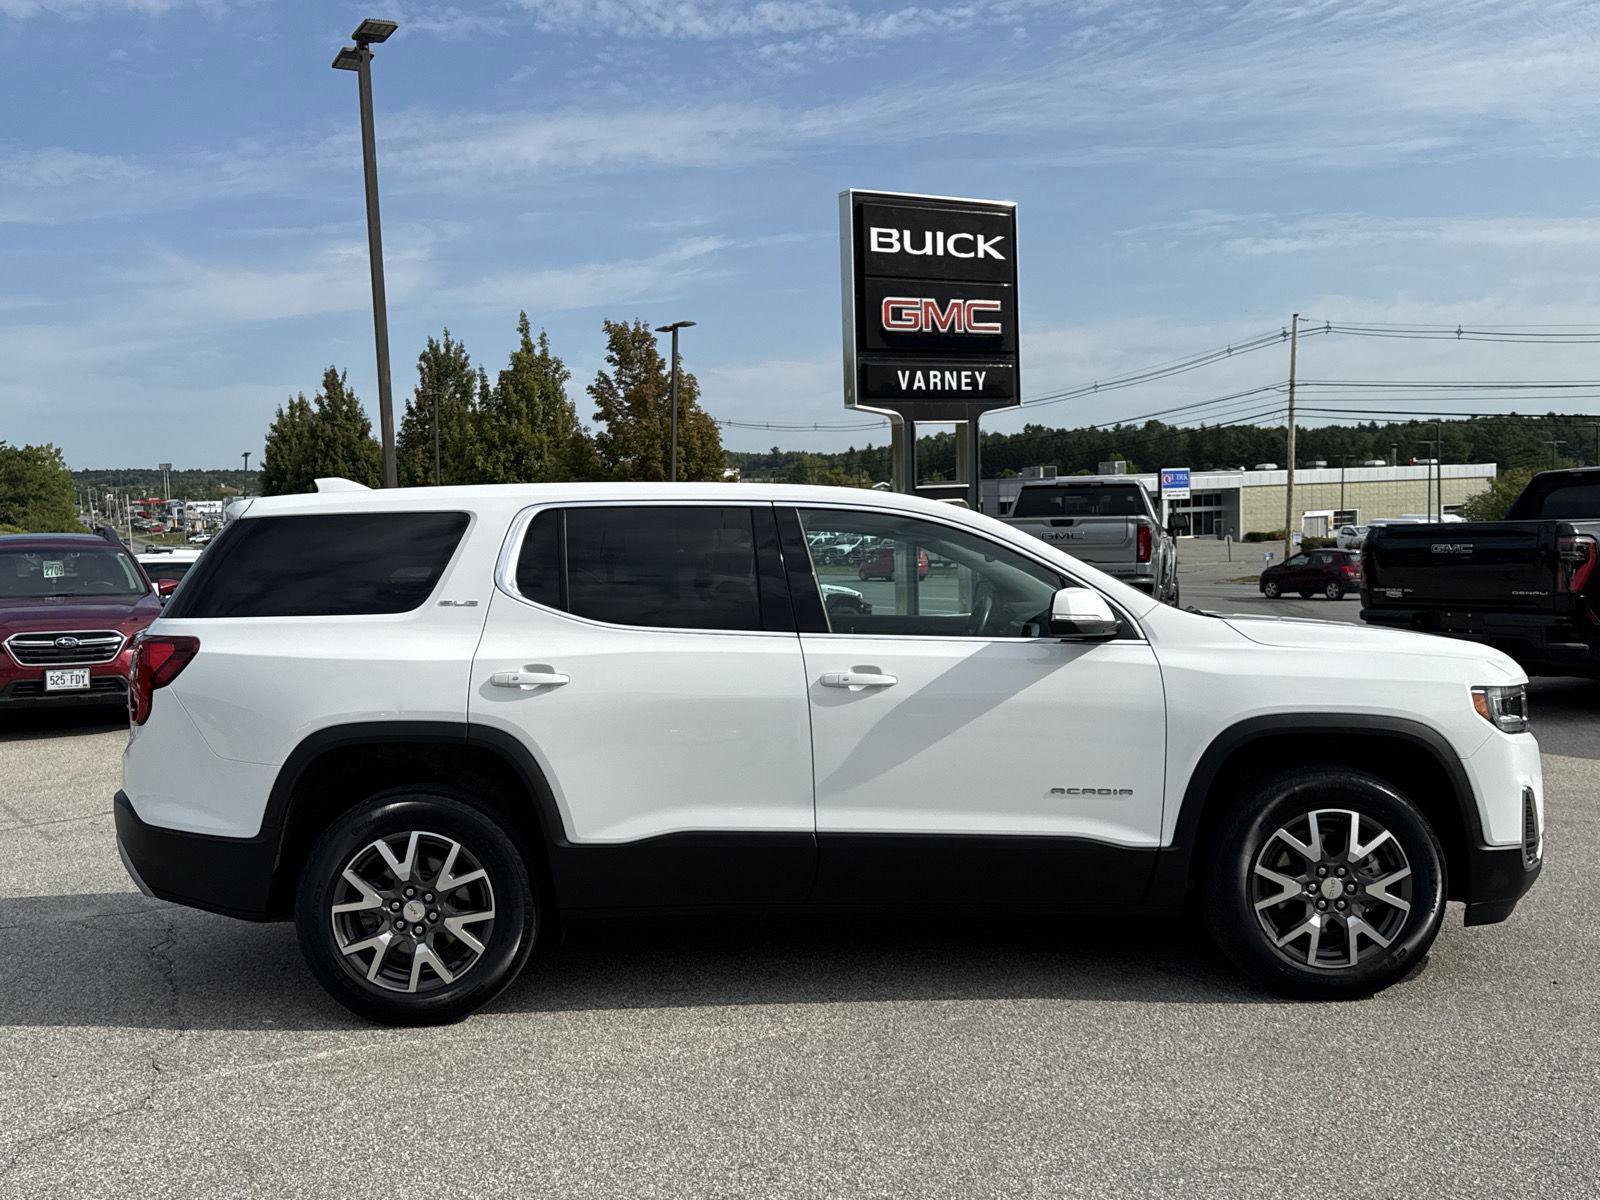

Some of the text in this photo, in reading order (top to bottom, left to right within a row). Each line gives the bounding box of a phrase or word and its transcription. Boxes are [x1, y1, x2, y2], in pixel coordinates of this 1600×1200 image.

[869, 226, 1006, 260] BUICK
[881, 296, 1002, 334] GMC
[897, 370, 987, 391] VARNEY
[1041, 531, 1083, 540] GMC
[1431, 544, 1474, 554] GMC
[50, 674, 86, 686] 525 FDY
[1050, 787, 1134, 796] ACADIA
